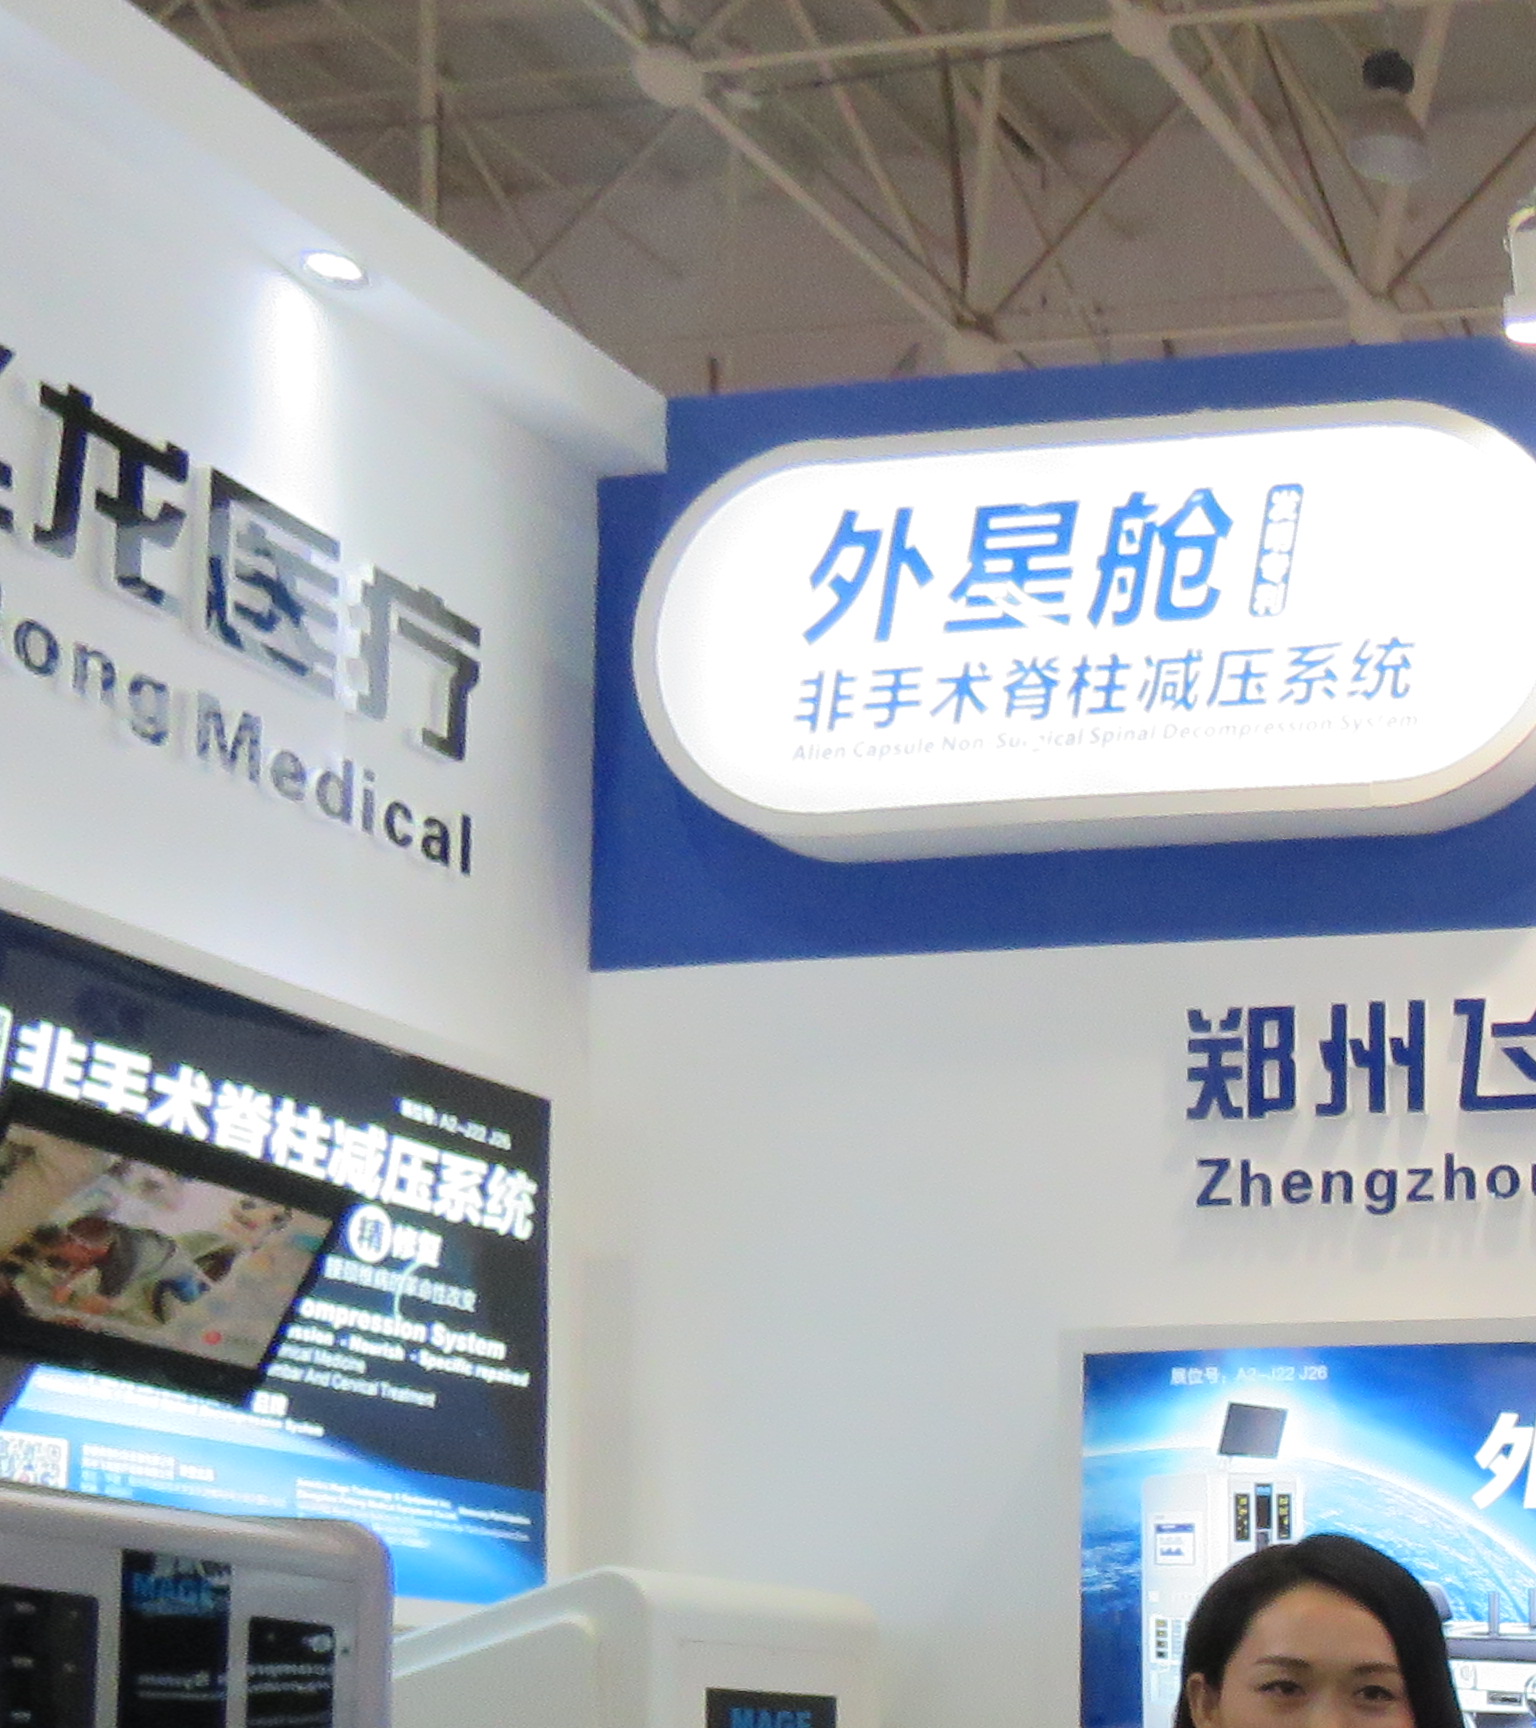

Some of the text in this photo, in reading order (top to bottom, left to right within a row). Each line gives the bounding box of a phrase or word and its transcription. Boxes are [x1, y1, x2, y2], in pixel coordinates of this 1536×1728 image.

[0, 344, 482, 761] 龙医疗
[803, 487, 1233, 645] 外星舱
[793, 636, 1417, 734] 非手术脊柱减压系统
[853, 741, 935, 760] Capsule
[199, 692, 472, 878] Medical
[10, 1019, 538, 1241] 非手术脊柱减压系统
[299, 1298, 507, 1360] ompression System
